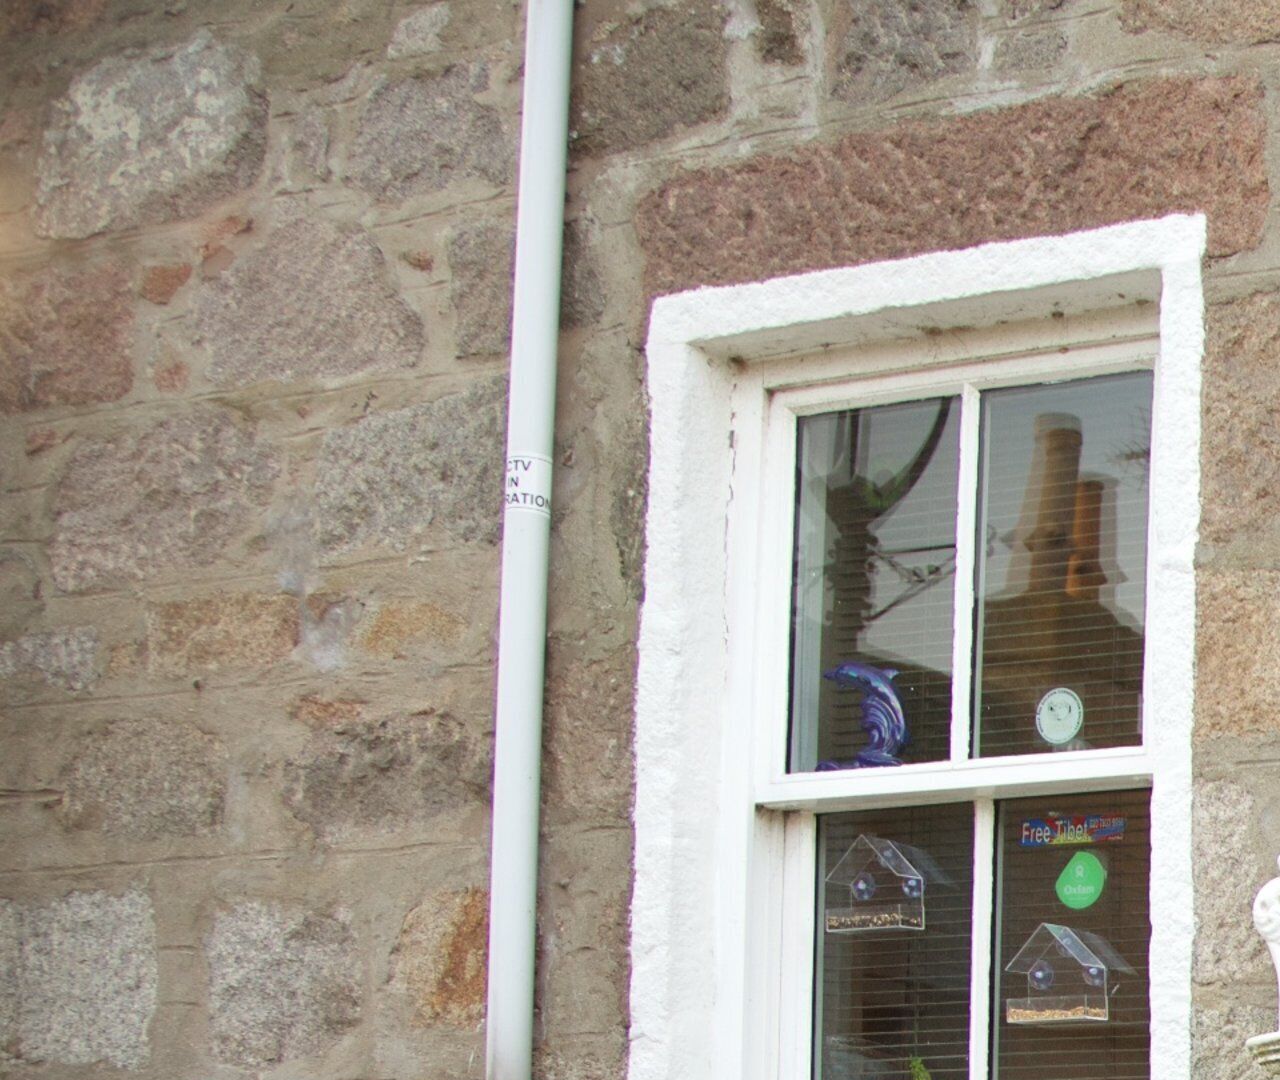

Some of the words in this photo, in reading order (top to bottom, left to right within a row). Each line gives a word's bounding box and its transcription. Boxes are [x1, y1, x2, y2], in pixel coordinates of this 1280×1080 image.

[508, 476, 518, 487] IN
[1022, 822, 1051, 844] Free
[1055, 819, 1088, 841] Tibet
[1064, 884, 1094, 895] Oxfam
